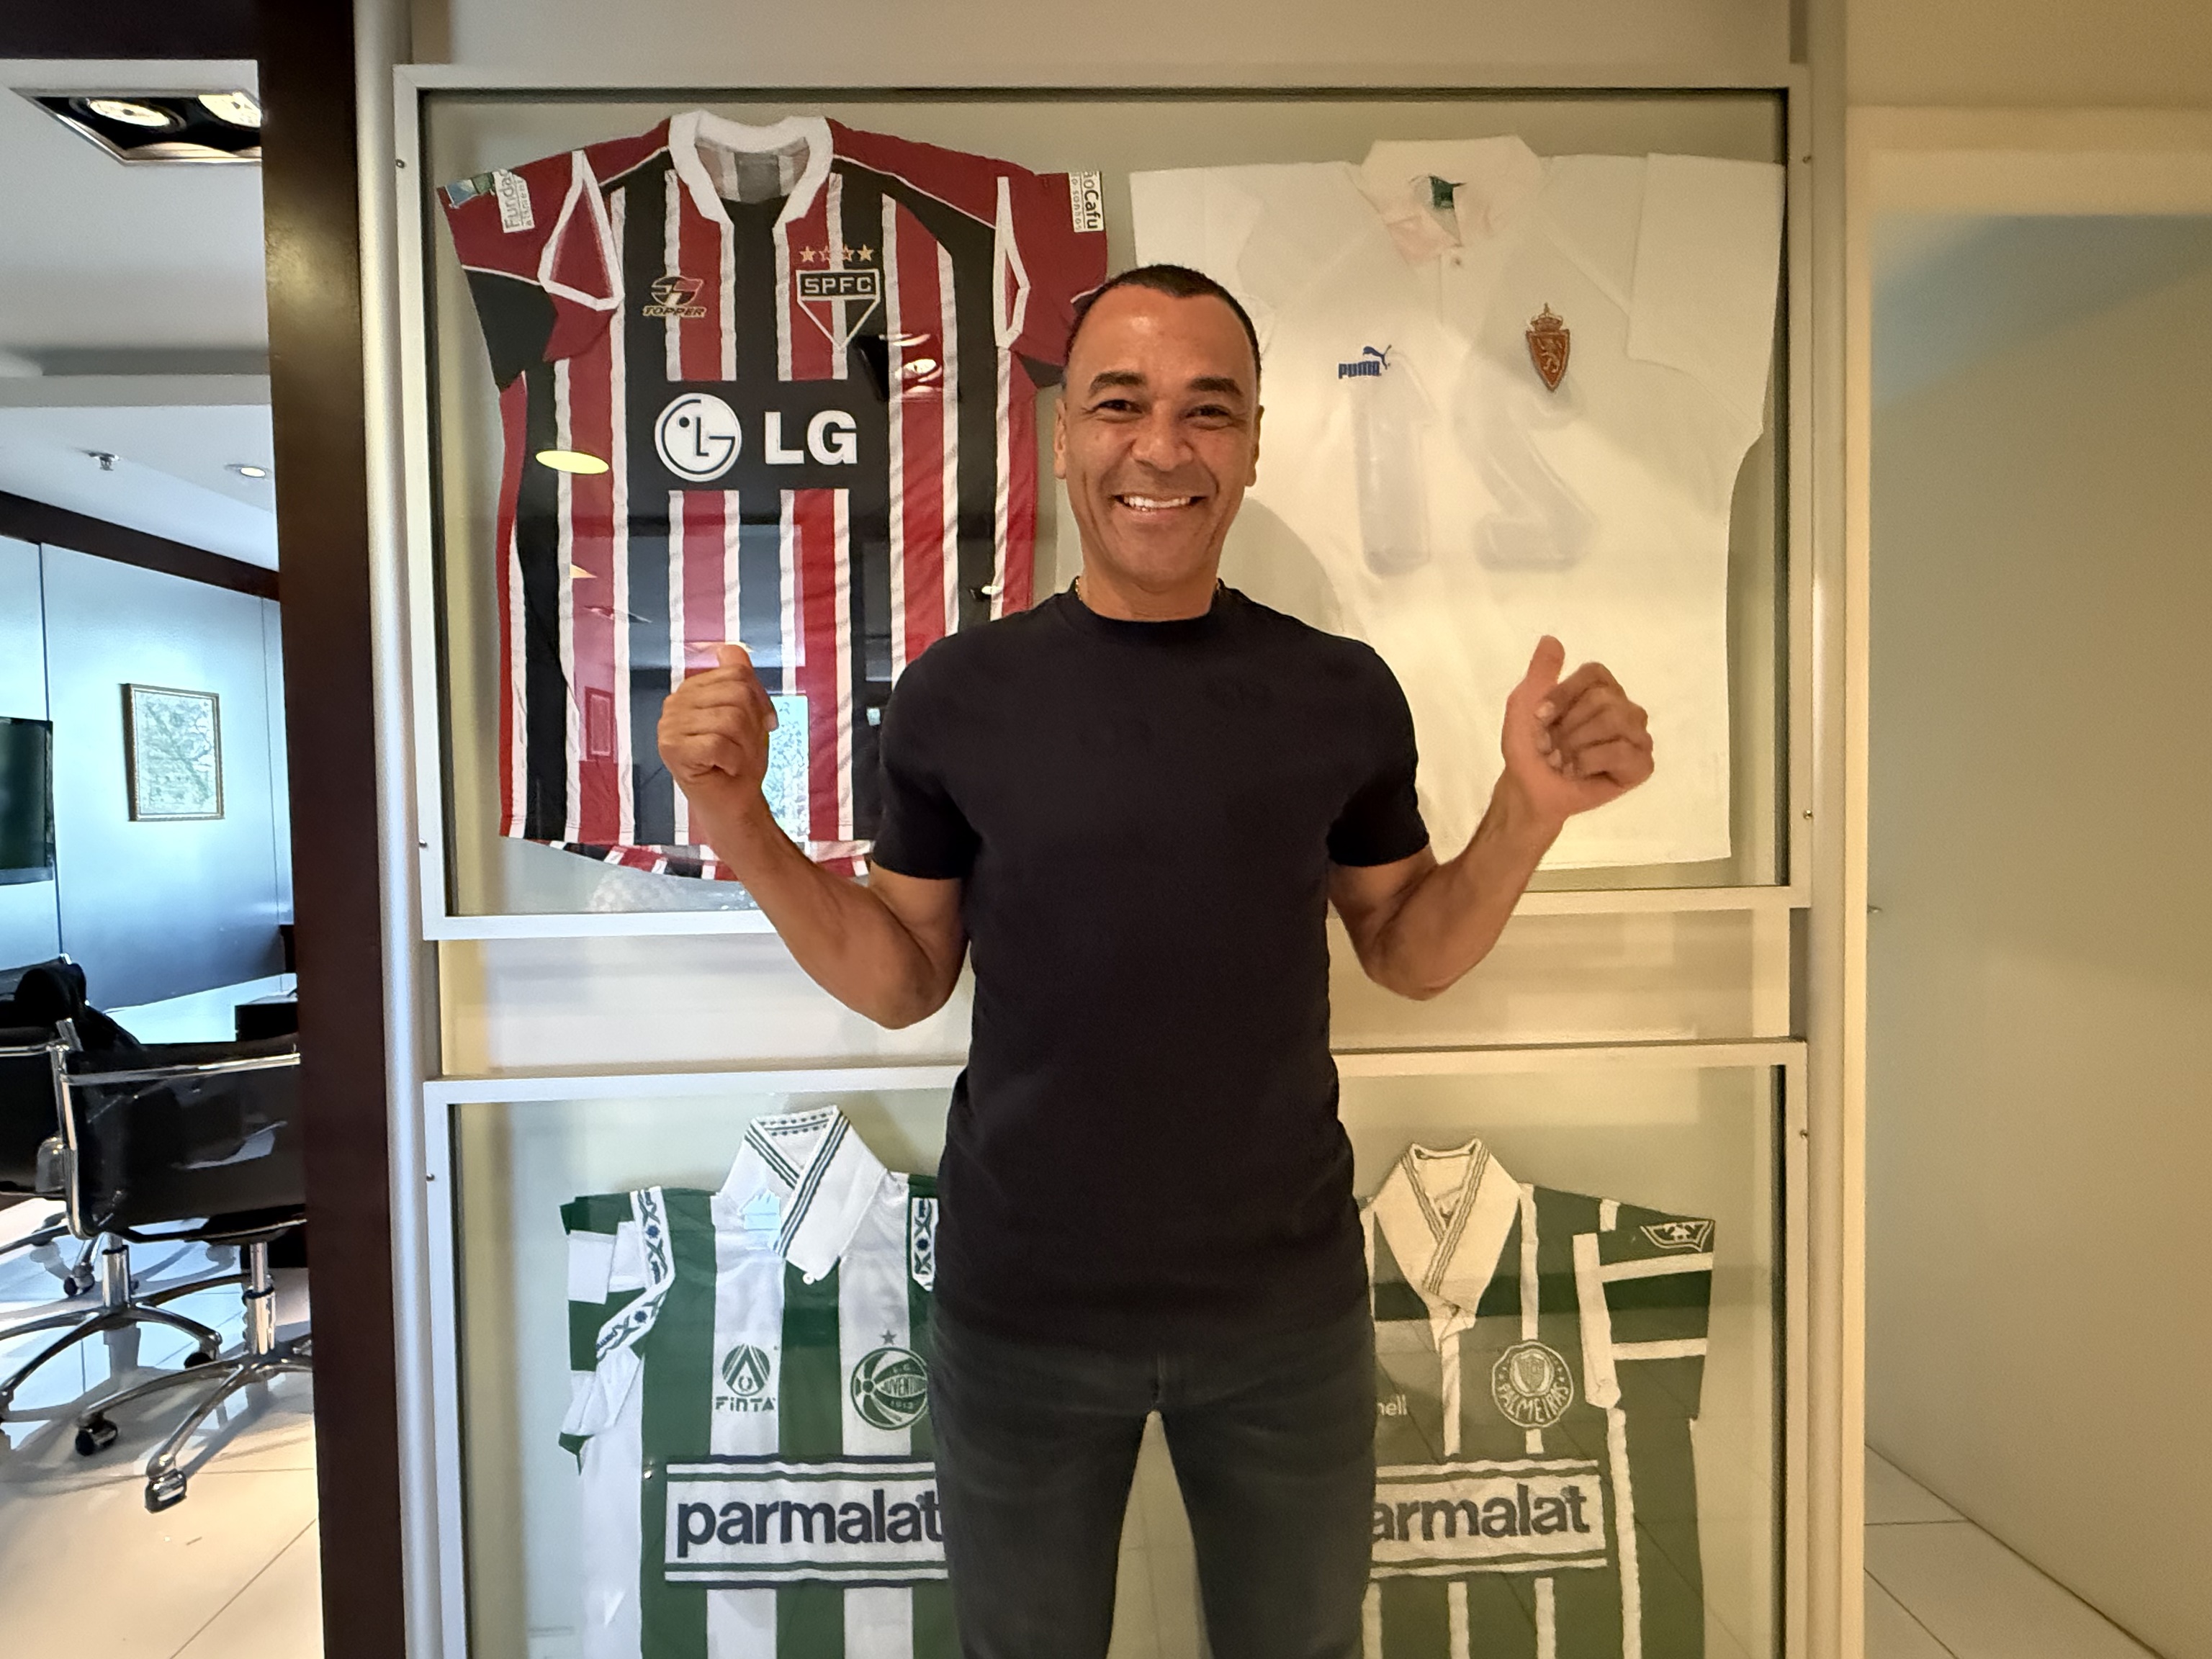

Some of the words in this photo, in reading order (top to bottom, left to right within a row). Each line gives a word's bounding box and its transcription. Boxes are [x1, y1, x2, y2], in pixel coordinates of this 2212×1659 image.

[644, 306, 706, 317] TOPPER
[804, 276, 872, 295] SPFC
[764, 410, 858, 465] LG
[677, 1488, 943, 1557] parmalat
[1372, 1483, 1590, 1541] armalat
